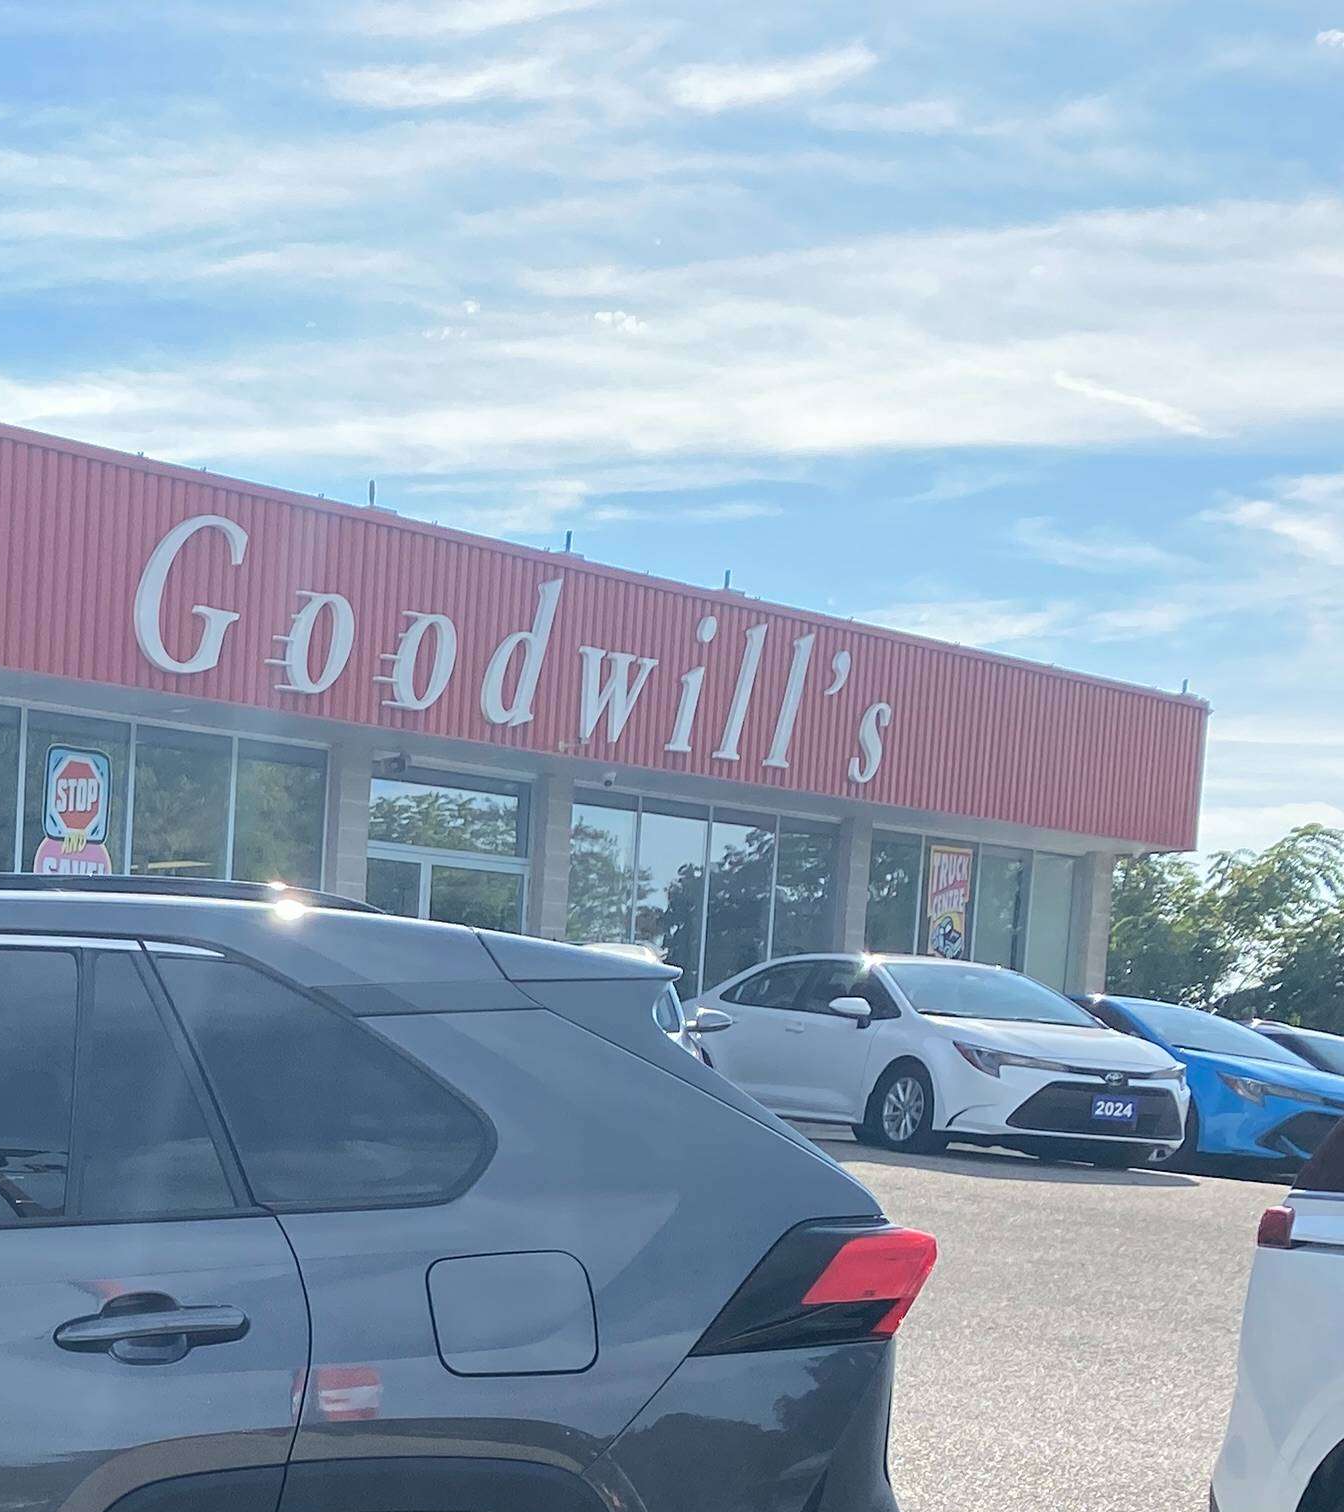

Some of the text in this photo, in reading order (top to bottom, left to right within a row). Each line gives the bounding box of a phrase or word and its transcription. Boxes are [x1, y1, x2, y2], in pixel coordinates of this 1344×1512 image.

[133, 514, 893, 784] Goodwill's
[56, 777, 100, 813] STOP
[61, 831, 87, 854] AND
[932, 851, 970, 894] TRUCK
[1094, 1101, 1133, 1118] 2024
